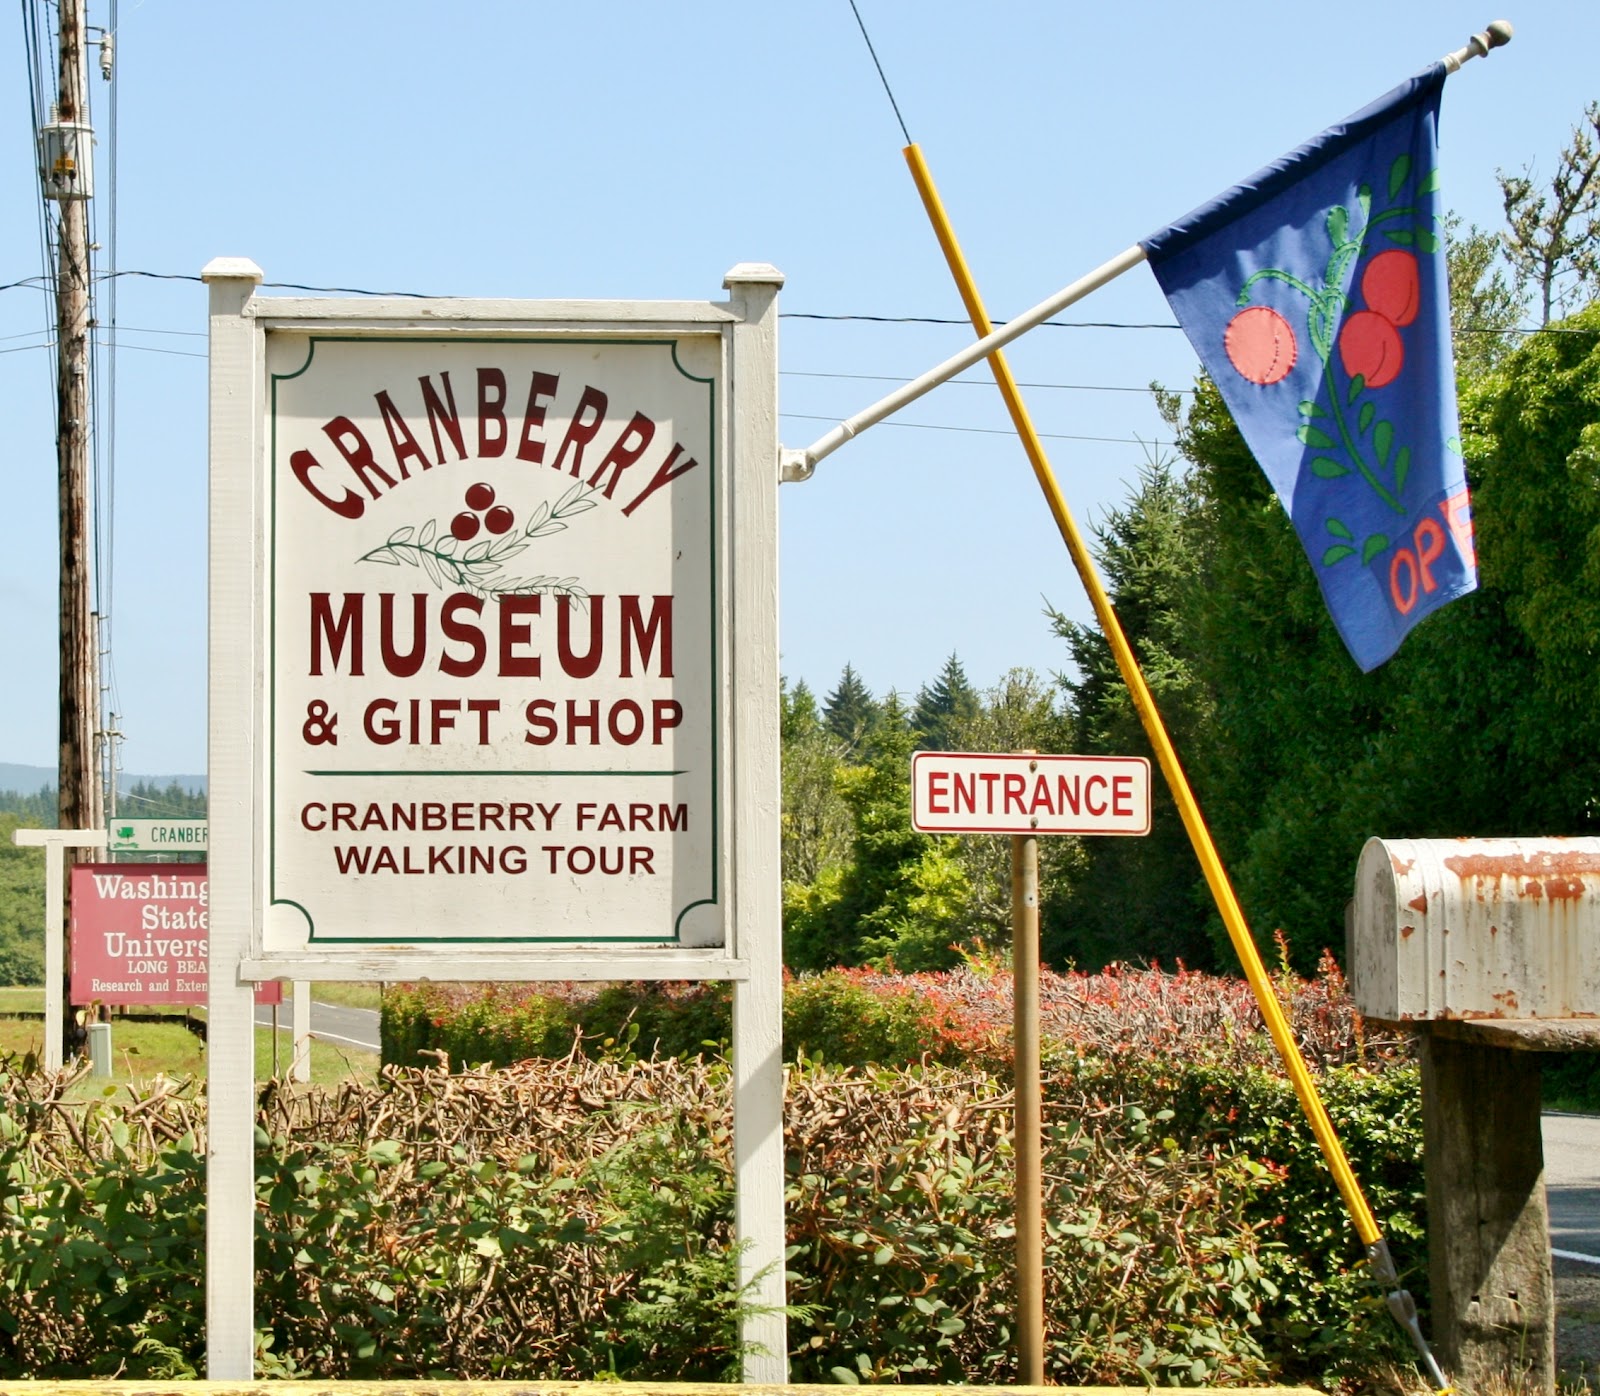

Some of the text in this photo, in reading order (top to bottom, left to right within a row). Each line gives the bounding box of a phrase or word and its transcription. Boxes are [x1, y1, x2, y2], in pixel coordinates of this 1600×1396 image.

[290, 367, 698, 518] CRANBERRY
[308, 592, 675, 679] MUSEUM
[302, 698, 684, 746] & GIFT SHOP
[928, 771, 1133, 817] ENTRANCE
[301, 802, 689, 832] CRANBERRY FARM
[334, 845, 656, 875] WALKING TOUR
[142, 904, 208, 930] State
[104, 932, 208, 957] Univers
[127, 960, 168, 974] LONG
[92, 978, 142, 992] Research
[148, 978, 169, 992] and
